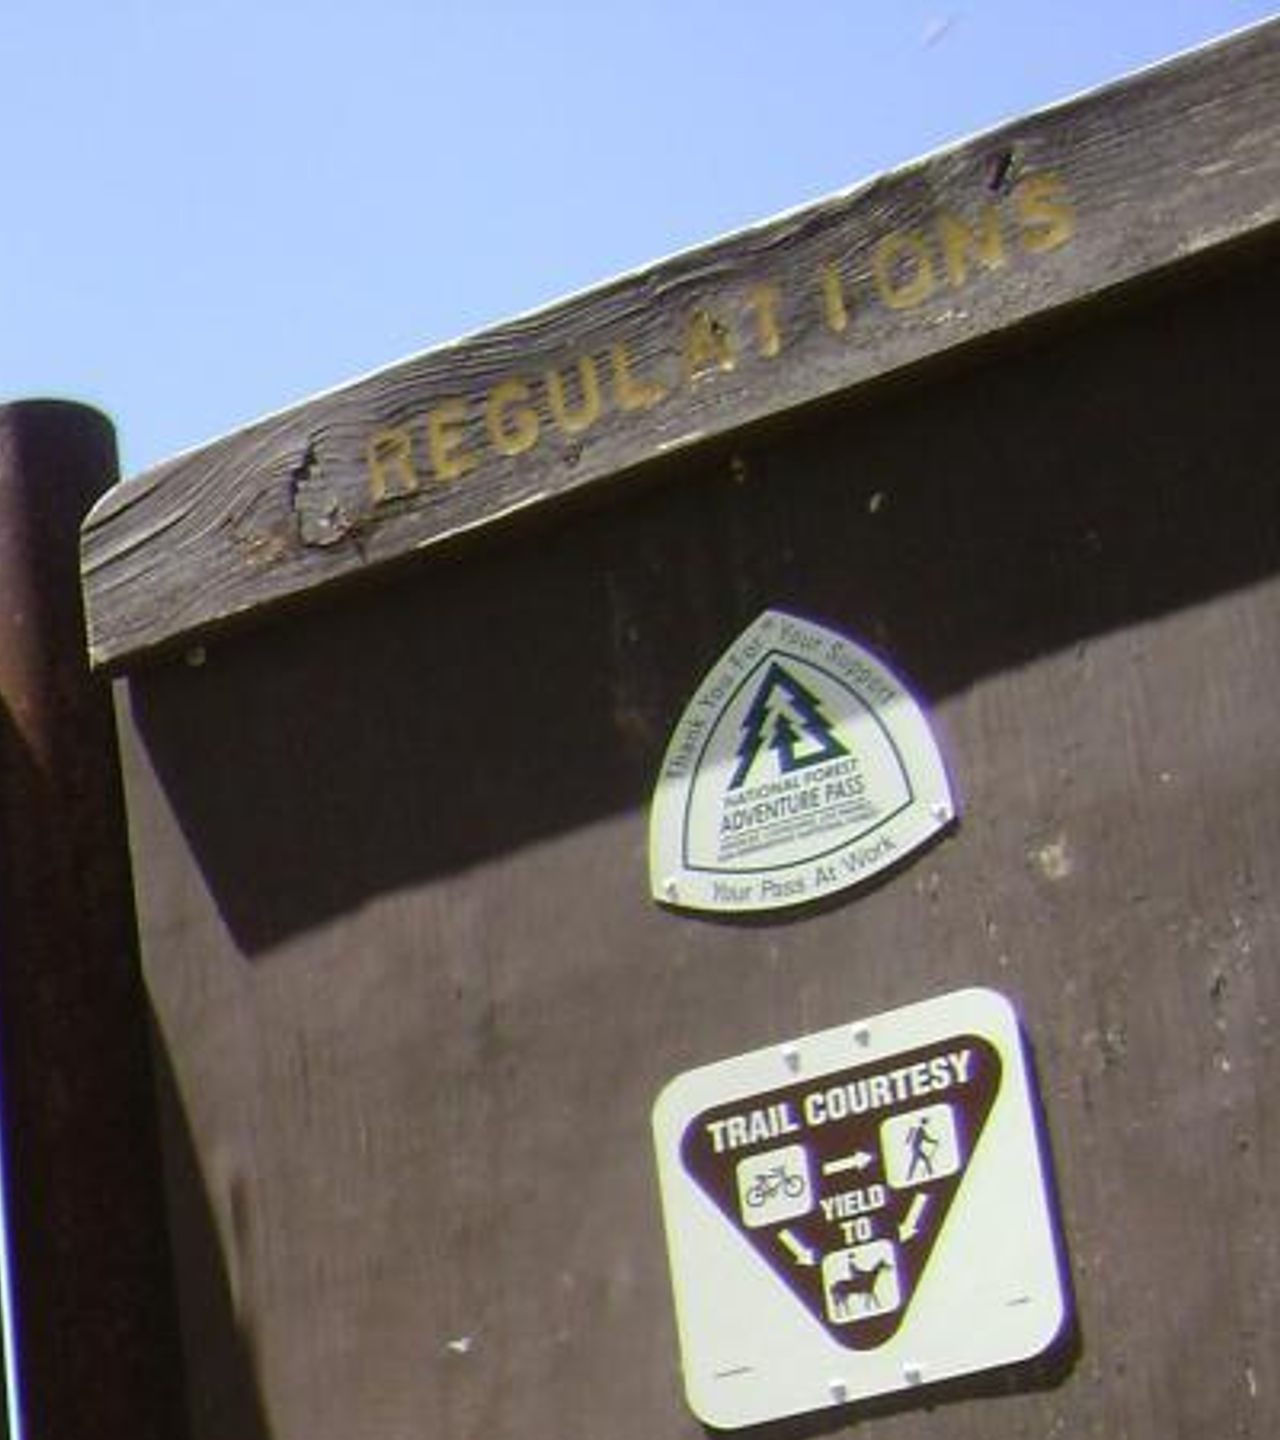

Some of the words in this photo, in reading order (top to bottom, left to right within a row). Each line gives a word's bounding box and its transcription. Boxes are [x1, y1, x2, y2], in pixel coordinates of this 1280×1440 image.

[361, 171, 1077, 504] REGULATIONS
[721, 786, 821, 831] ADVENTURE
[825, 774, 866, 803] PASS
[723, 776, 801, 807] NATIONAL
[804, 757, 858, 784] FOREST
[761, 876, 806, 898] Pass
[815, 865, 838, 888] At
[840, 837, 898, 874] Work
[706, 1102, 800, 1156] TRAIL
[803, 1050, 973, 1127] COURTESY
[820, 1184, 887, 1222] YIELD
[840, 1220, 873, 1246] TO
